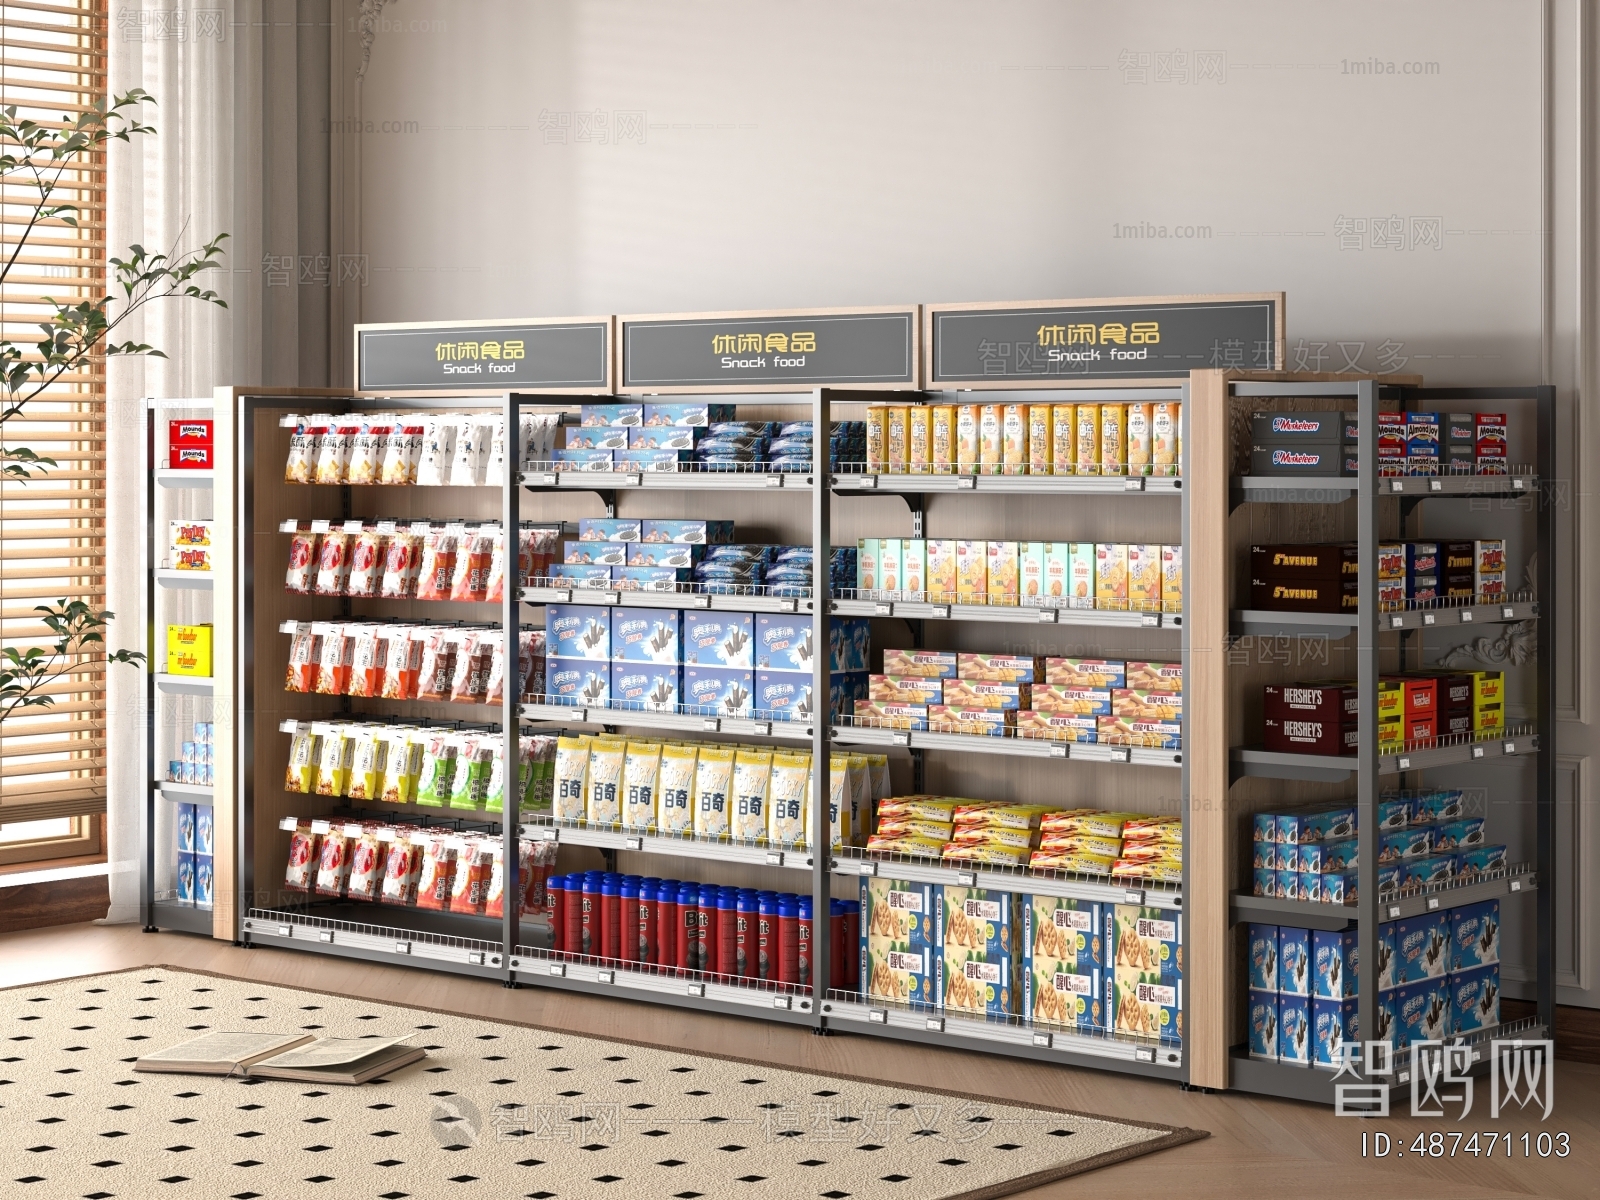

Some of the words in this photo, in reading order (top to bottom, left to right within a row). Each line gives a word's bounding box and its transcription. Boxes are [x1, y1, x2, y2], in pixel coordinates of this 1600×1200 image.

[1036, 321, 1159, 345] 休闲食品
[435, 340, 525, 361] 休闲食品
[711, 331, 816, 355] 休闲食品
[721, 356, 769, 369] Snack
[772, 355, 805, 368] food
[1048, 348, 1100, 362] Snack
[1110, 347, 1147, 361] food
[443, 363, 481, 375] Snack
[487, 362, 515, 374] food
[1409, 425, 1428, 435] Almond
[1480, 425, 1504, 436] Mounds
[1283, 556, 1317, 566] AVENUE
[1283, 589, 1317, 599] AVENUE
[1284, 688, 1322, 705] HERSHEY'S
[1284, 721, 1322, 738] HERSHEY'S
[560, 779, 581, 798] 百奇
[594, 782, 616, 802] 百奇
[629, 785, 651, 805] 百奇
[665, 789, 687, 808] 百奇
[702, 792, 724, 812] 百奇
[739, 795, 762, 816] 百奇
[776, 799, 800, 819] 百奇
